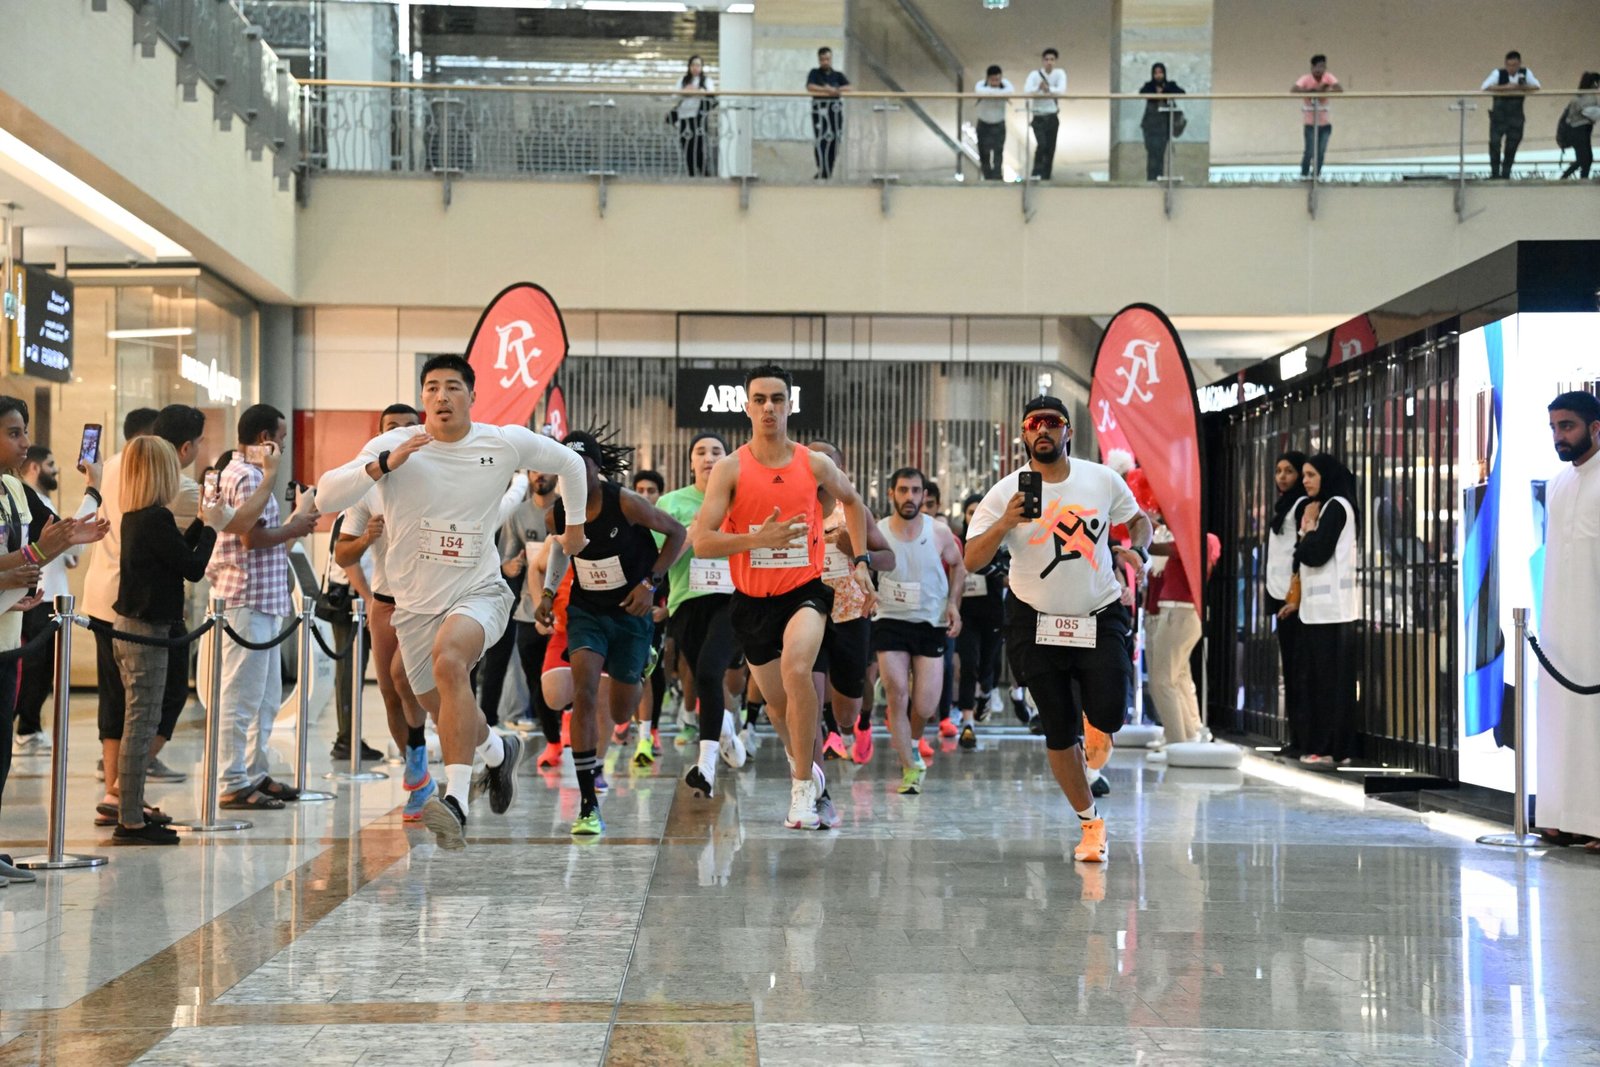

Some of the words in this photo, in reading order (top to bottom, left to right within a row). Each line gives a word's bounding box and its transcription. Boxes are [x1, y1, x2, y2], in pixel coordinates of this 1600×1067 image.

[439, 535, 465, 549] 154
[589, 570, 608, 579] 146
[704, 570, 722, 580] 153
[1055, 618, 1079, 630] 085
